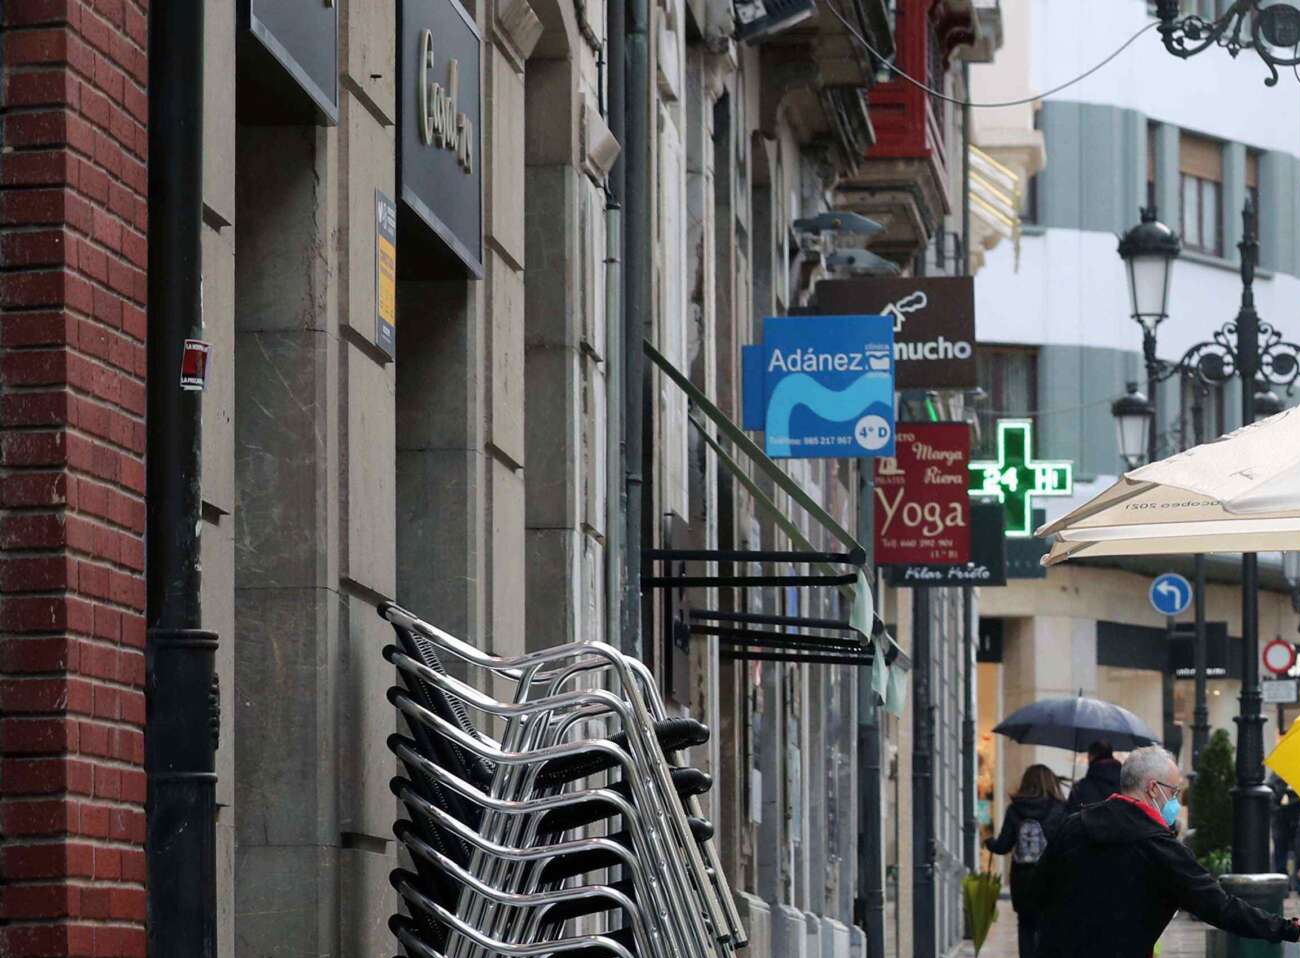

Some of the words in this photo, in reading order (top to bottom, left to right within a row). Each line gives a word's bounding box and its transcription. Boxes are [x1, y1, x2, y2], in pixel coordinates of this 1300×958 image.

[768, 347, 863, 373] Adánez
[912, 442, 963, 466] Marga
[924, 466, 963, 485] Riera
[983, 468, 1017, 492] 24
[874, 487, 966, 537] Yoga
